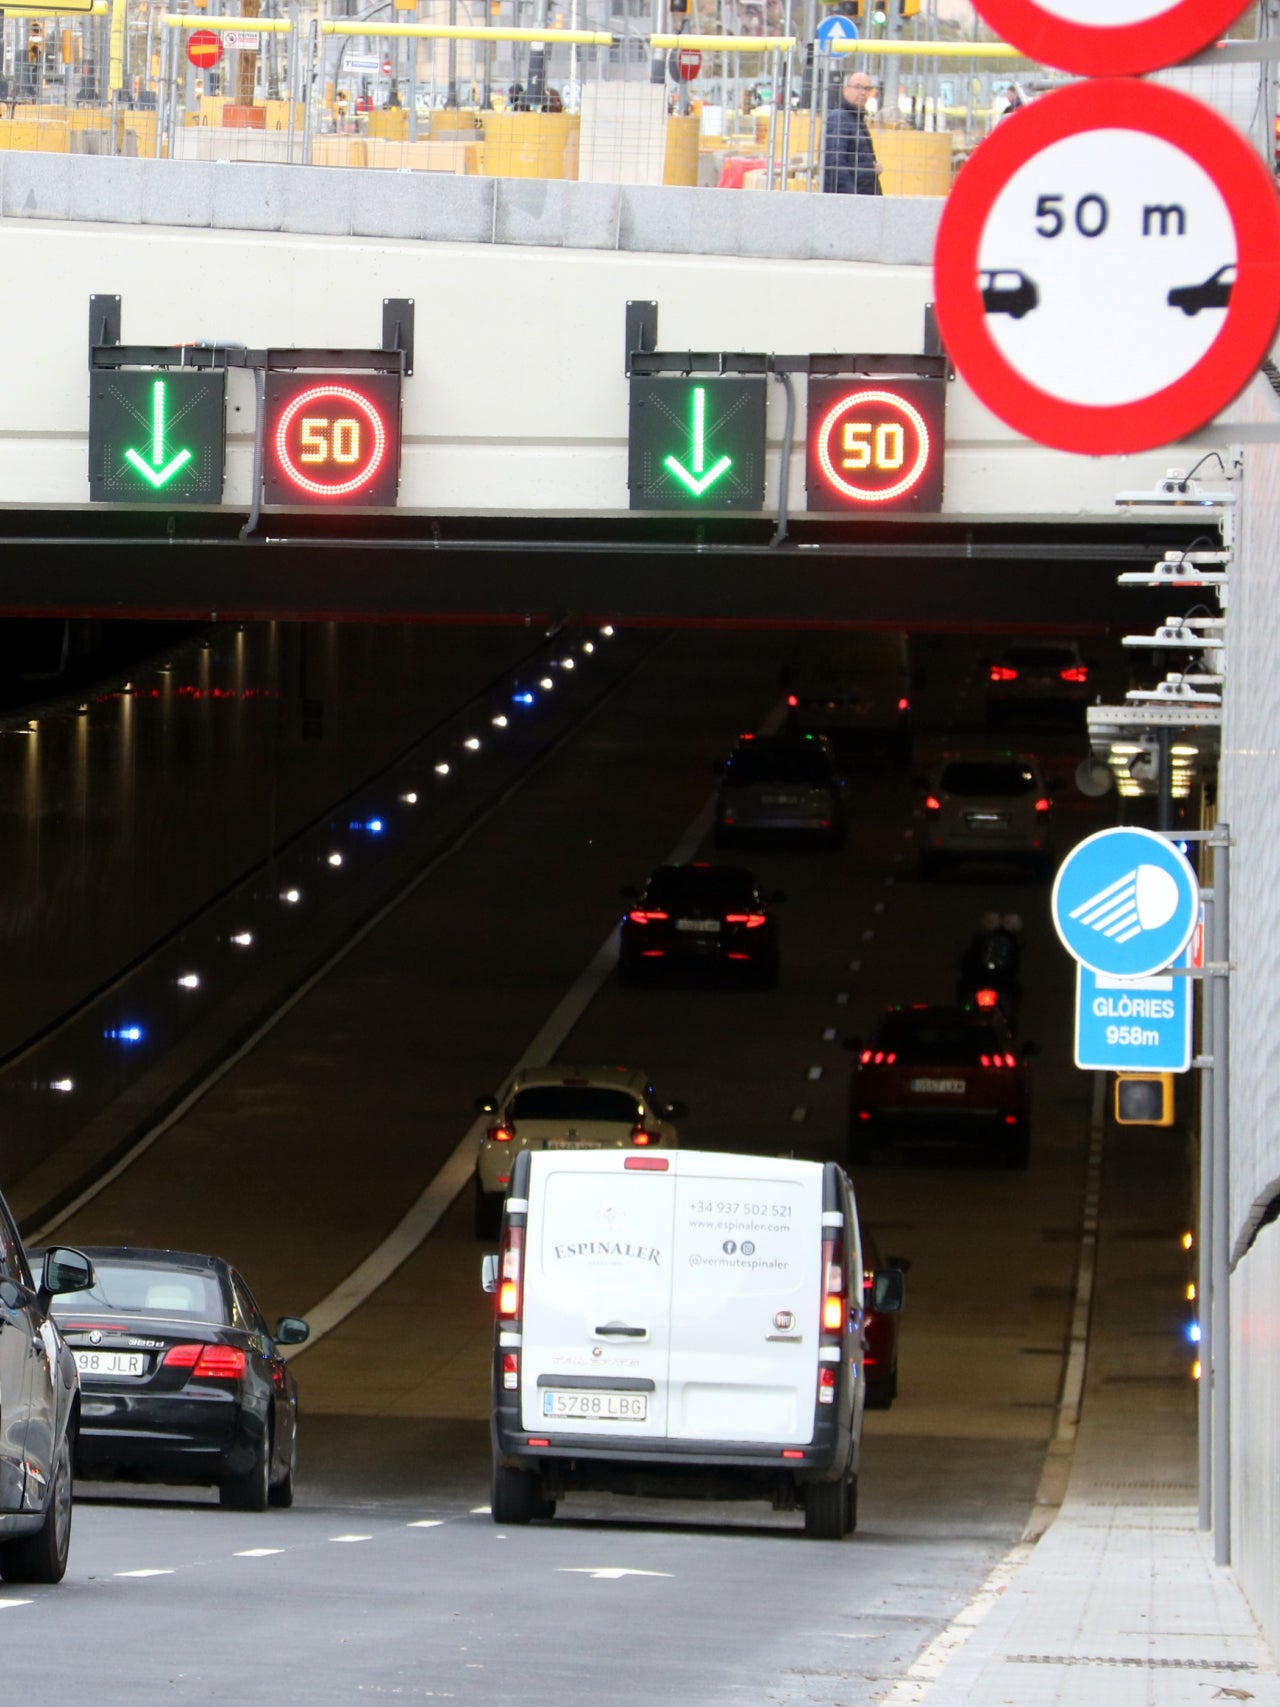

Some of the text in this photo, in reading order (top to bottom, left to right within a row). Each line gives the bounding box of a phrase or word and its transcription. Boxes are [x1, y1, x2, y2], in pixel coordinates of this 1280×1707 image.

[1035, 193, 1187, 238] 50 m
[301, 418, 360, 462] 50
[843, 423, 904, 468] 50
[1092, 994, 1175, 1019] GLÒRIES
[1106, 1025, 1160, 1046] 958m
[689, 1201, 792, 1218] +34 937 502 521
[689, 1219, 790, 1233] www.espinaler.com
[554, 1241, 661, 1266] ESPINALER
[688, 1254, 789, 1271] @vermutespinaler
[78, 1354, 139, 1373] 98 JLR
[557, 1396, 641, 1415] 5788 LBG
